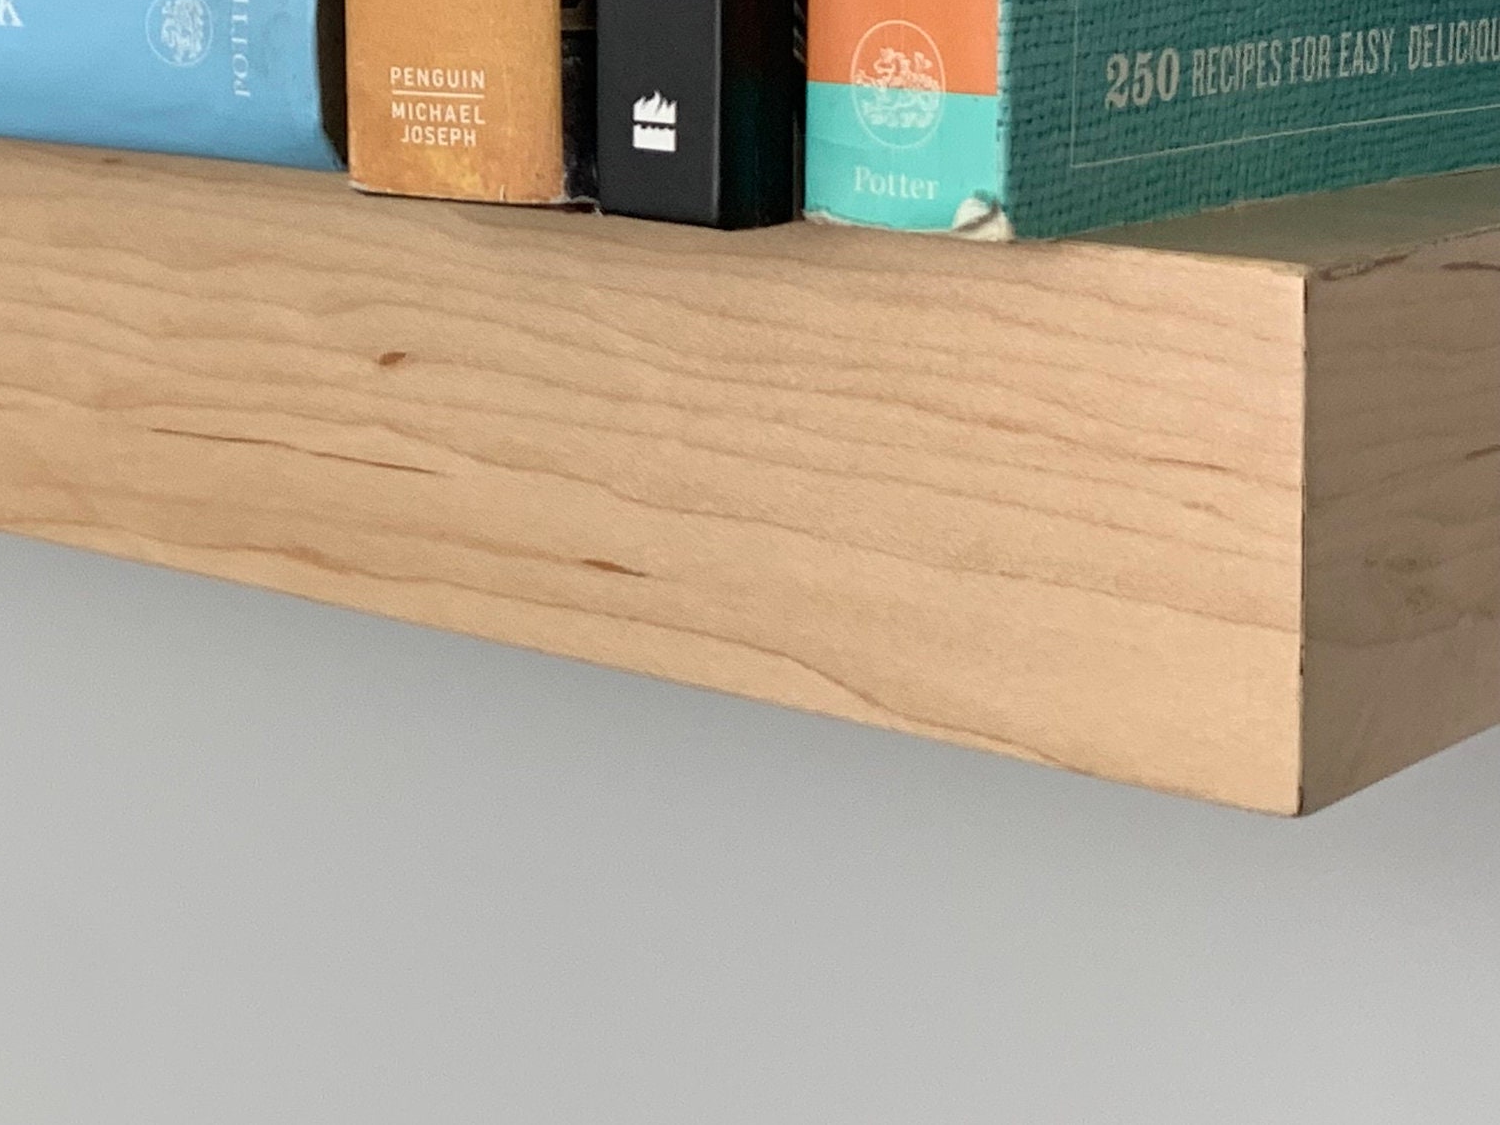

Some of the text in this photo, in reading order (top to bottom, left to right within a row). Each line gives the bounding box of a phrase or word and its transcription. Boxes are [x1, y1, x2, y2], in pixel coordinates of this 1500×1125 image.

[389, 66, 486, 89] PENGUIN
[1104, 46, 1180, 109] 250
[1191, 38, 1283, 97] RECIPES
[1288, 33, 1331, 85] FOR
[1339, 27, 1398, 78] EASY,
[391, 100, 487, 125] MICHAEL
[400, 124, 477, 148] JOSEPH
[853, 165, 941, 201] Potter
